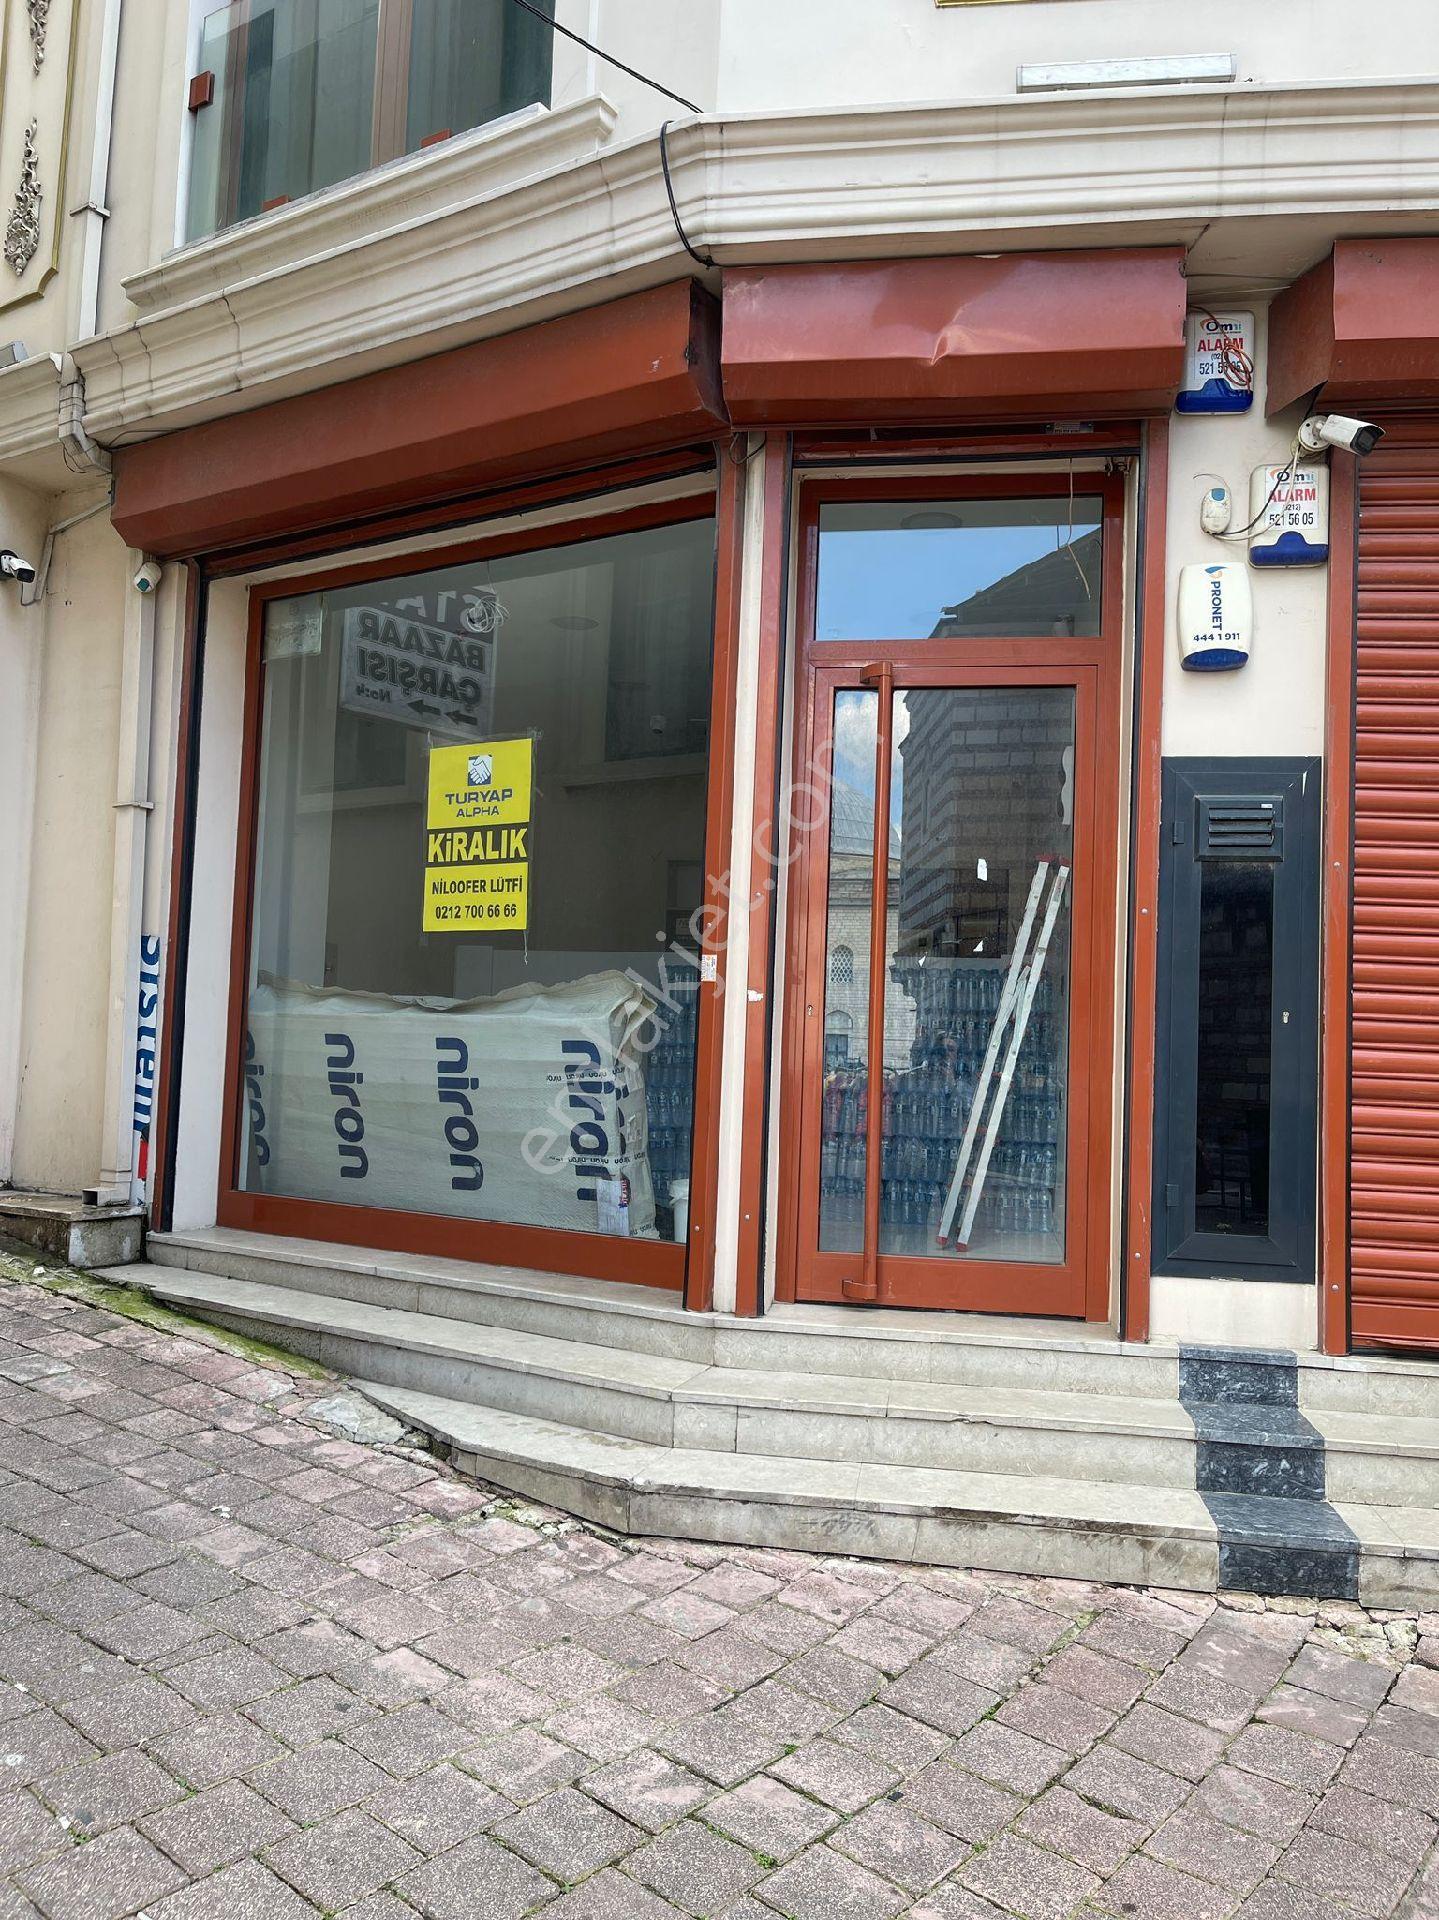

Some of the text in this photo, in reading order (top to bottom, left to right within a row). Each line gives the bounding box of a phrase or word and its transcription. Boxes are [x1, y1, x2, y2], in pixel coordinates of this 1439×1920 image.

[1197, 338, 1244, 352] ALARM
[1199, 362, 1214, 375] 521
[1269, 488, 1316, 503] ALARM
[1269, 512, 1314, 526] 521 56 05
[1210, 580, 1223, 631] PRONET
[1193, 633, 1215, 642] 444
[444, 788, 513, 806] TURYAP
[456, 806, 500, 818] ALPHA
[435, 903, 517, 919] 0212 700 66 66
[324, 1033, 369, 1179] niron
[435, 1037, 484, 1191] niron
